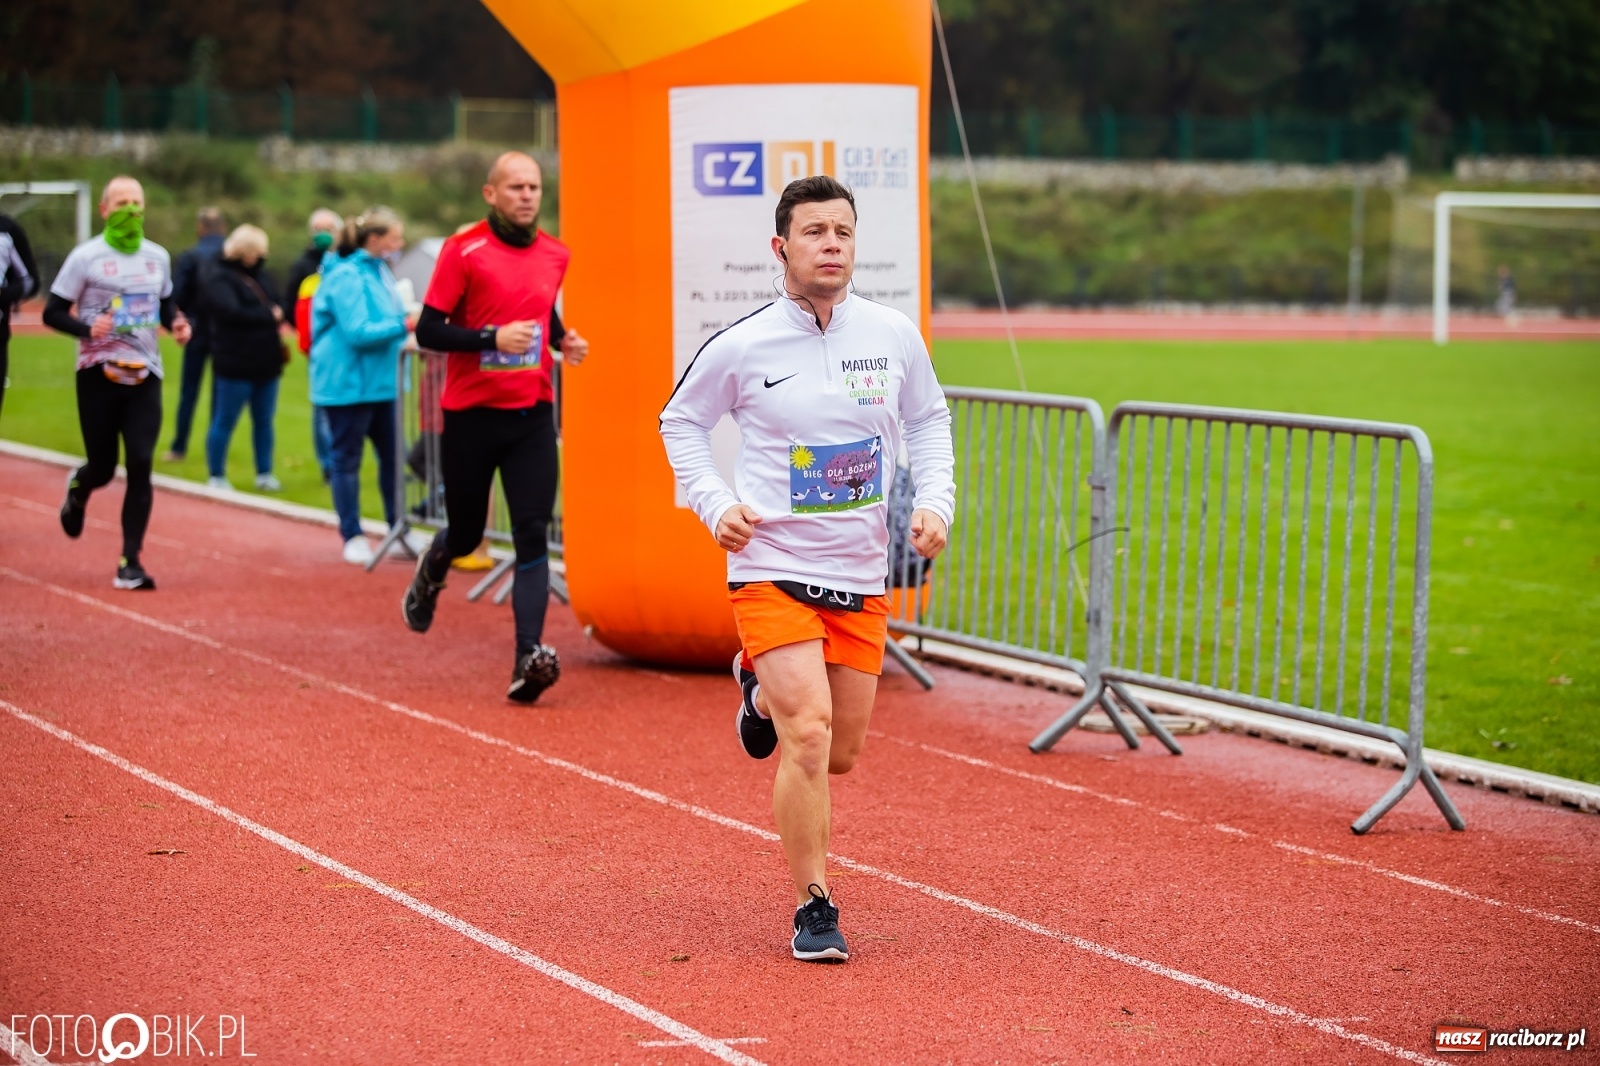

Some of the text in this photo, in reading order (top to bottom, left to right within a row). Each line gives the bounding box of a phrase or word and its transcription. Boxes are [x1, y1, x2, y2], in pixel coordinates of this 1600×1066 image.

[703, 152, 757, 187] CZ
[842, 357, 888, 373] MATEUSZ
[803, 470, 822, 478] BIEG
[827, 468, 843, 478] DLA
[847, 483, 875, 501] 299
